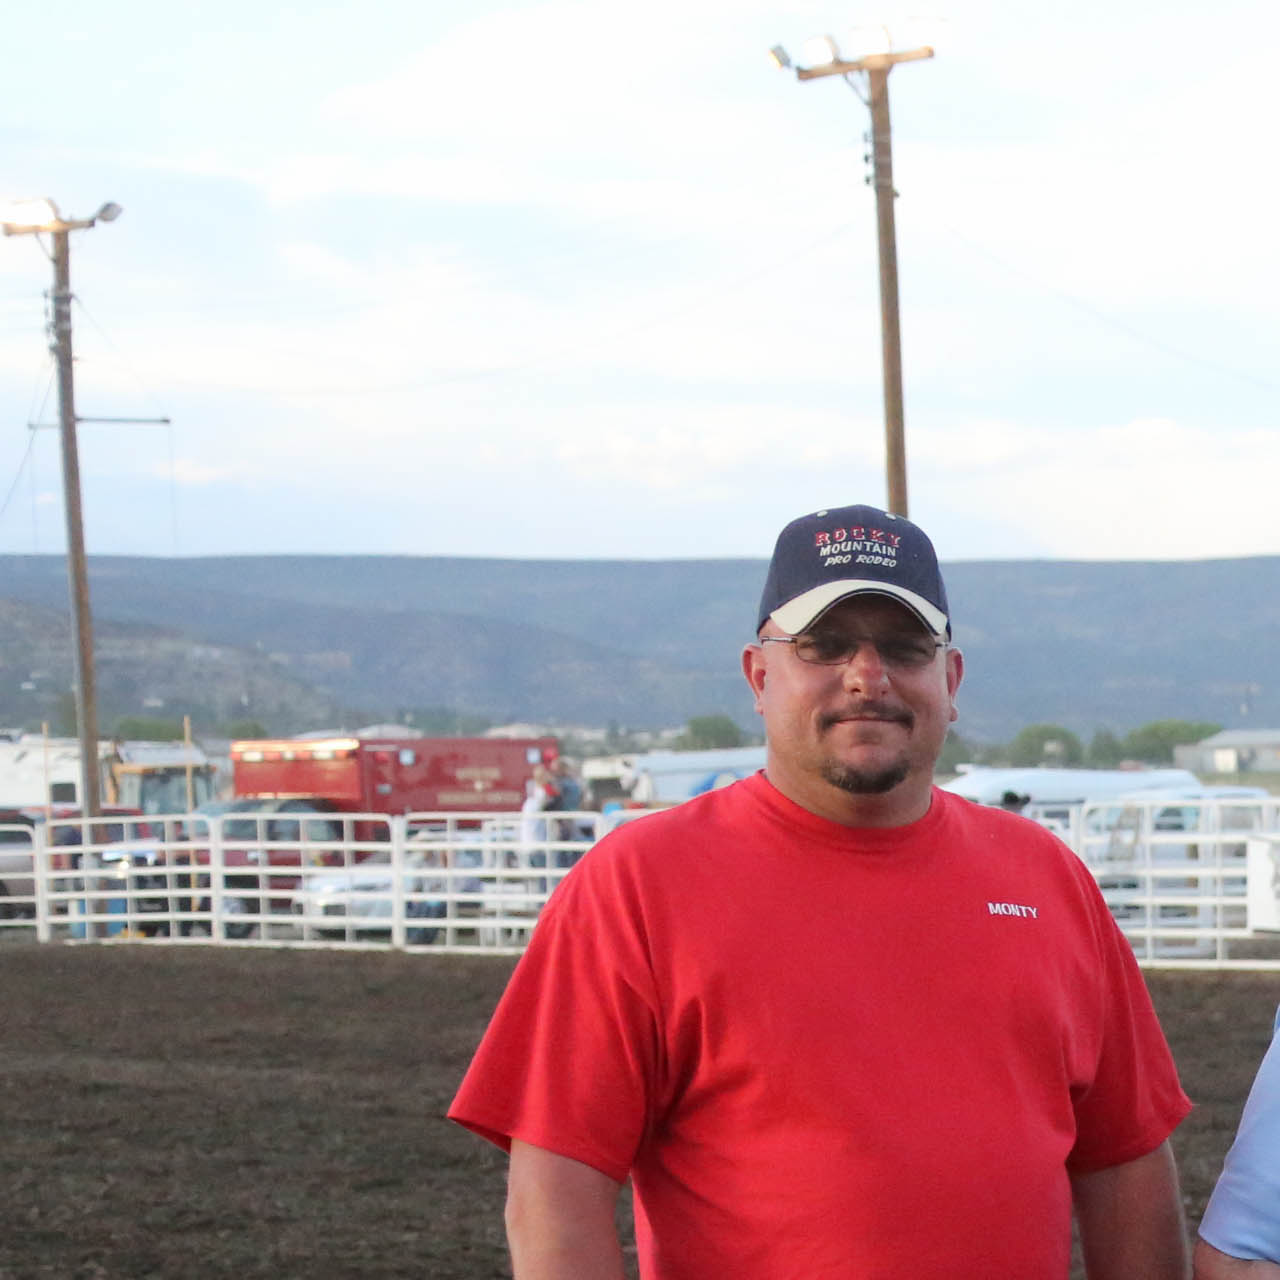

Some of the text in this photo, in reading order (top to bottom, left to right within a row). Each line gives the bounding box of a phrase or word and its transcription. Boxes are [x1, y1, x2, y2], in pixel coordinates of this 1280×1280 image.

[815, 525, 901, 548] ROCKY
[819, 541, 896, 557] MOUNTAIN
[824, 555, 897, 568] PRO RODEO
[987, 902, 1038, 918] MONTY
